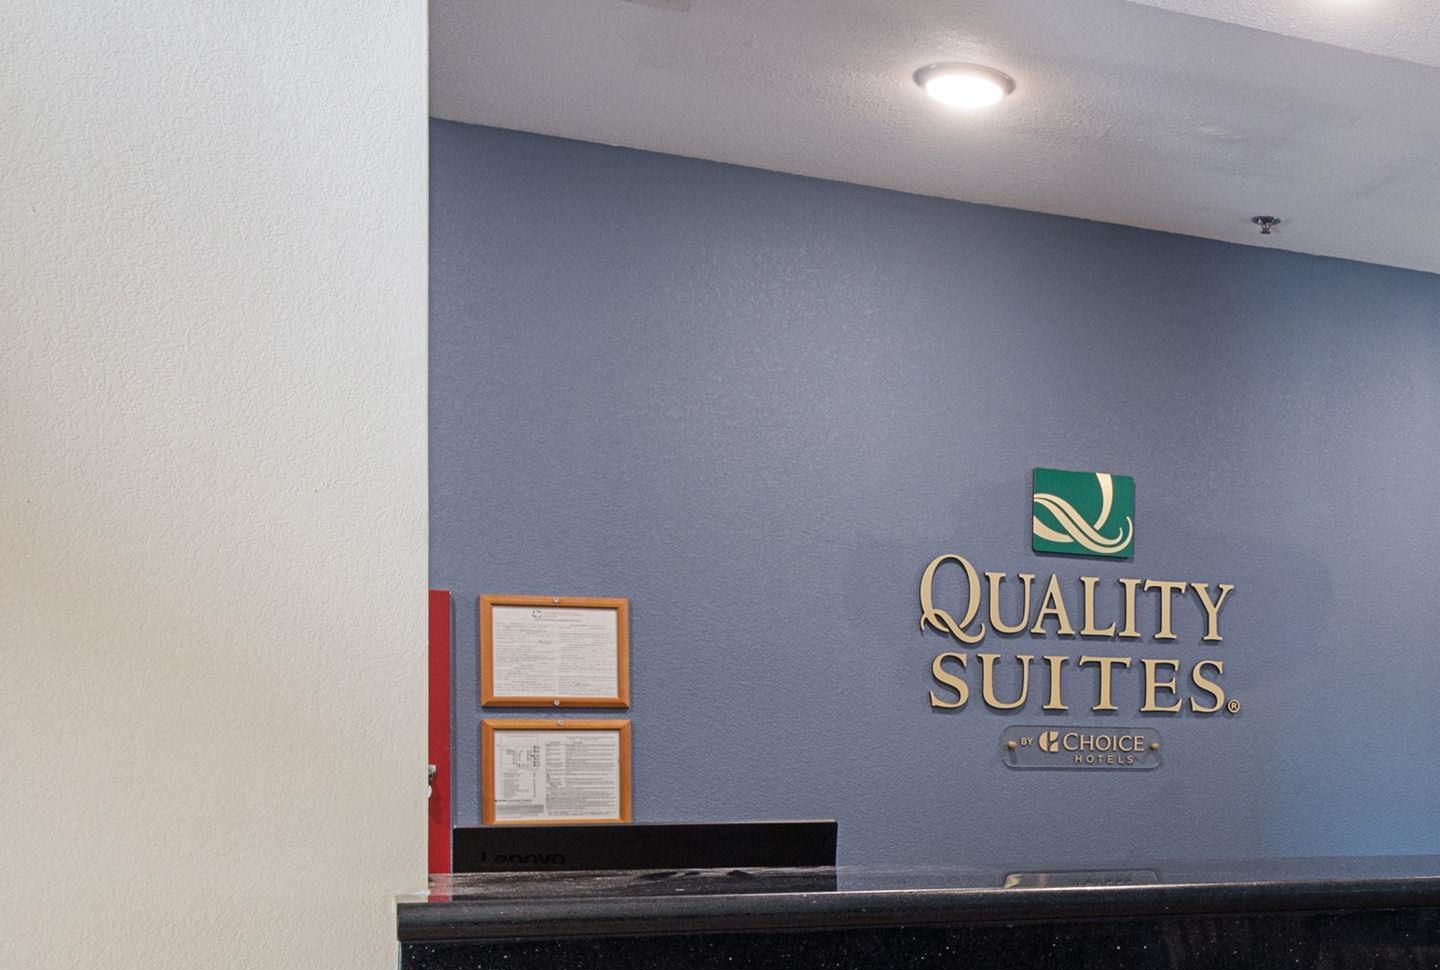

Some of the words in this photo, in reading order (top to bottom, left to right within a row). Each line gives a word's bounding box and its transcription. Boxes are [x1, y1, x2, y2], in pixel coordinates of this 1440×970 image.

[919, 553, 1234, 644] QUALITY
[1020, 736, 1034, 746] BY
[1062, 732, 1145, 753] CHOICE
[1074, 753, 1134, 765] HOTELS
